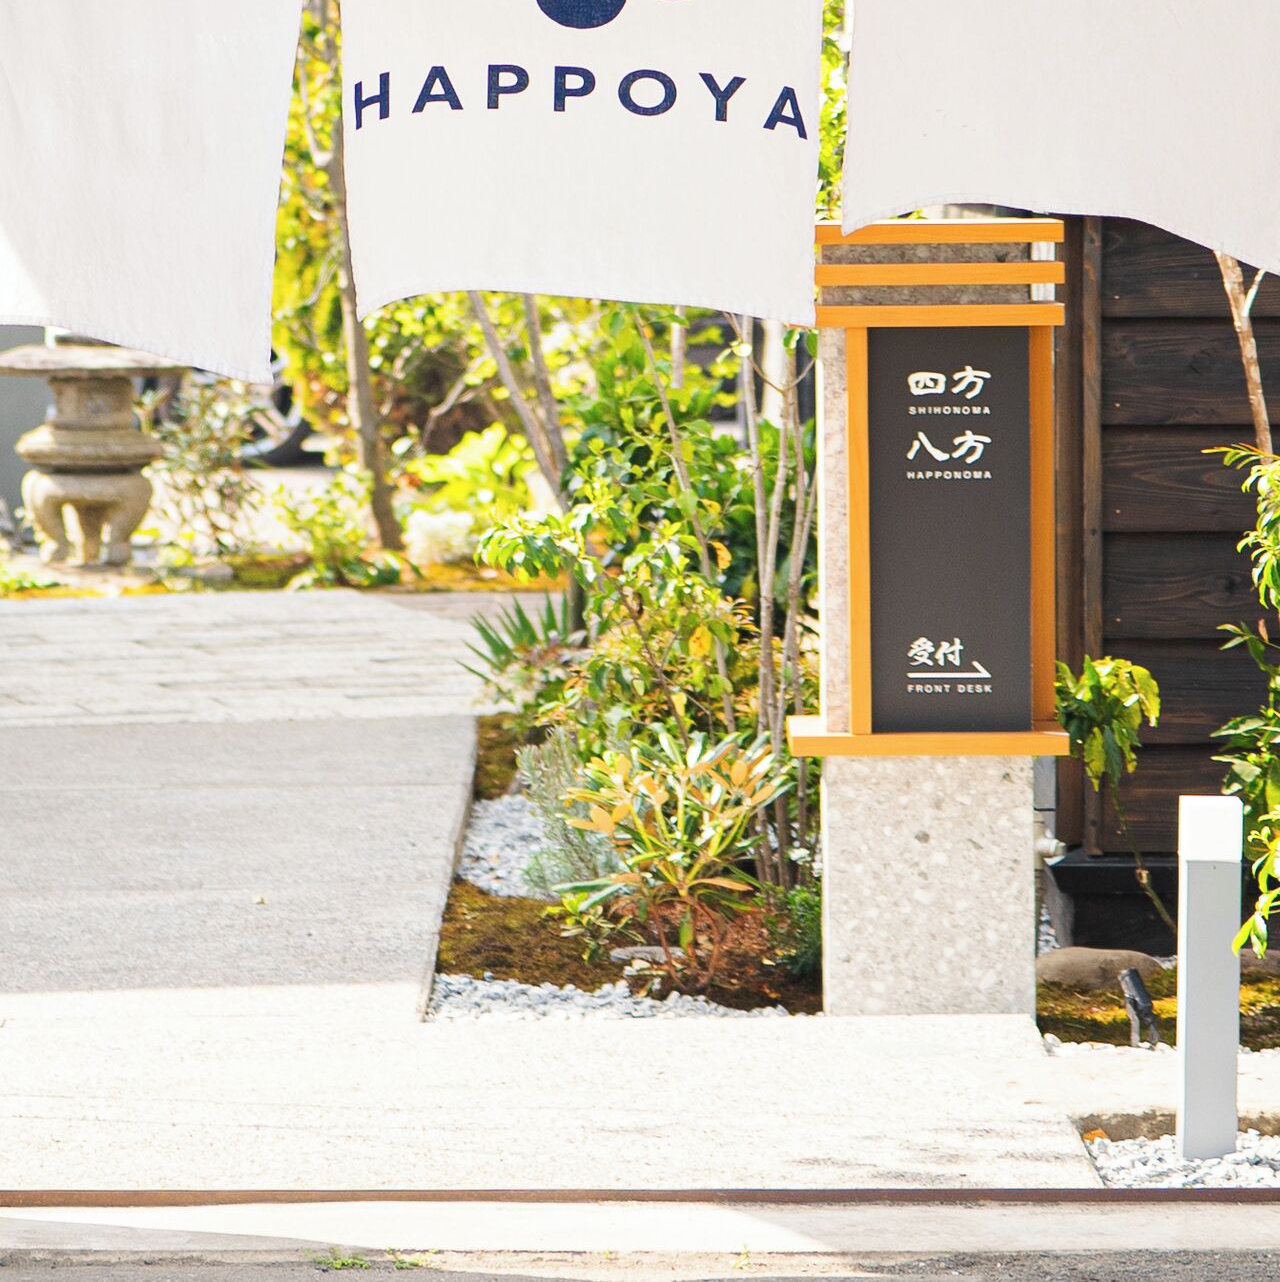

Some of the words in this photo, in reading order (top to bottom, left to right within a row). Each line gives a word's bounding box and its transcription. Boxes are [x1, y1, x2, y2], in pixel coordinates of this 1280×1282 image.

[354, 64, 808, 140] HAPPOYA
[907, 365, 992, 400] 四方
[908, 405, 991, 416] SHIHONOMA
[906, 429, 992, 464] 八方
[906, 470, 992, 480] HAPPONOMA
[906, 636, 964, 667] 受付
[906, 683, 951, 694] FRONT
[956, 683, 993, 694] DESK
